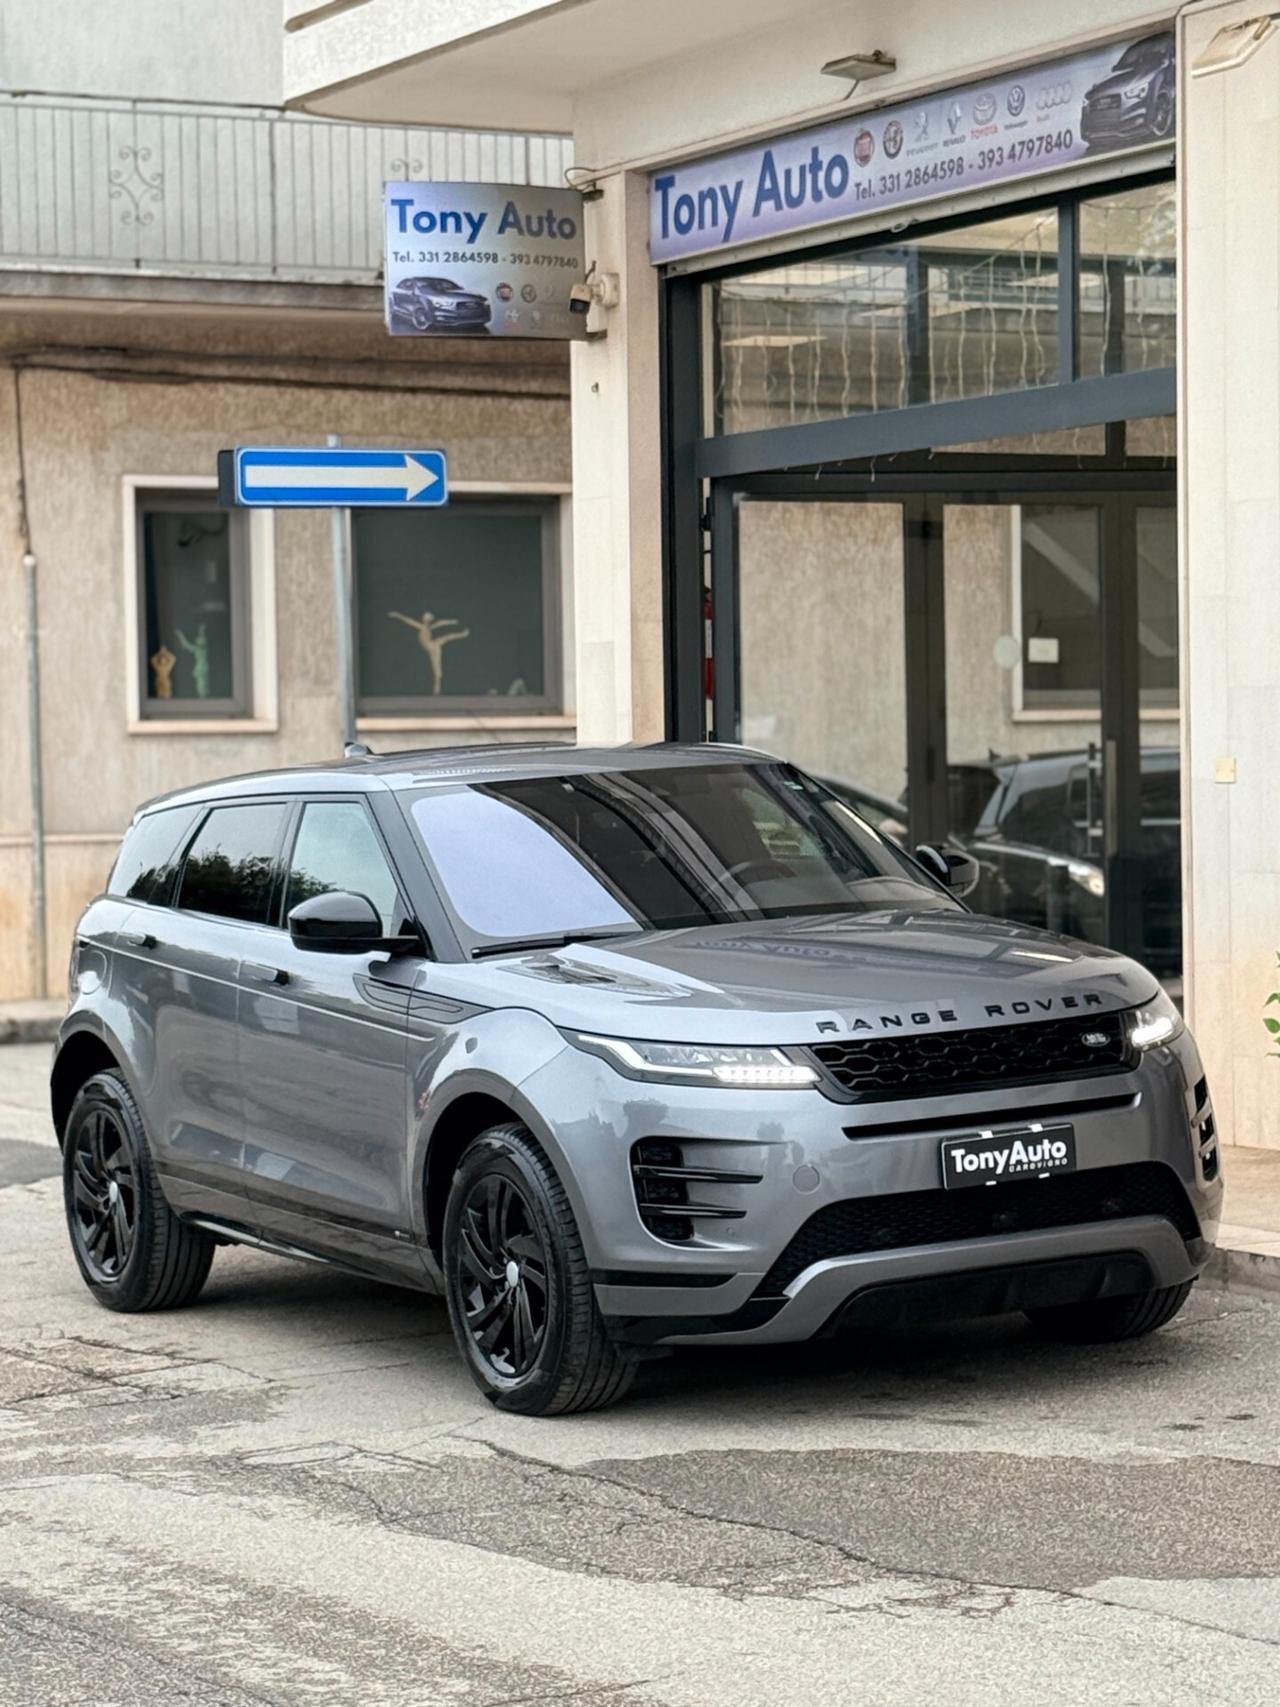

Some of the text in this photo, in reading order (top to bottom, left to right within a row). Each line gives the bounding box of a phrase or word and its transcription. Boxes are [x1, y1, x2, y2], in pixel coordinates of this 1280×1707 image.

[854, 179, 876, 201] Tel.
[879, 172, 901, 195] 331
[904, 156, 964, 188] 2864598
[977, 148, 1004, 171] 393
[1006, 129, 1073, 163] 4797840
[654, 146, 849, 243] Tony Auto
[390, 198, 577, 244] Tony Auto
[392, 251, 415, 263] Tel.
[418, 251, 440, 263] 331
[443, 252, 499, 264] 2864598
[509, 253, 531, 265] 393
[532, 255, 579, 269] 4797840
[815, 993, 1103, 1034] RANGE ROVER
[951, 1139, 1067, 1175] TonyAuto
[1008, 1157, 1068, 1173] CAROVIGNO
